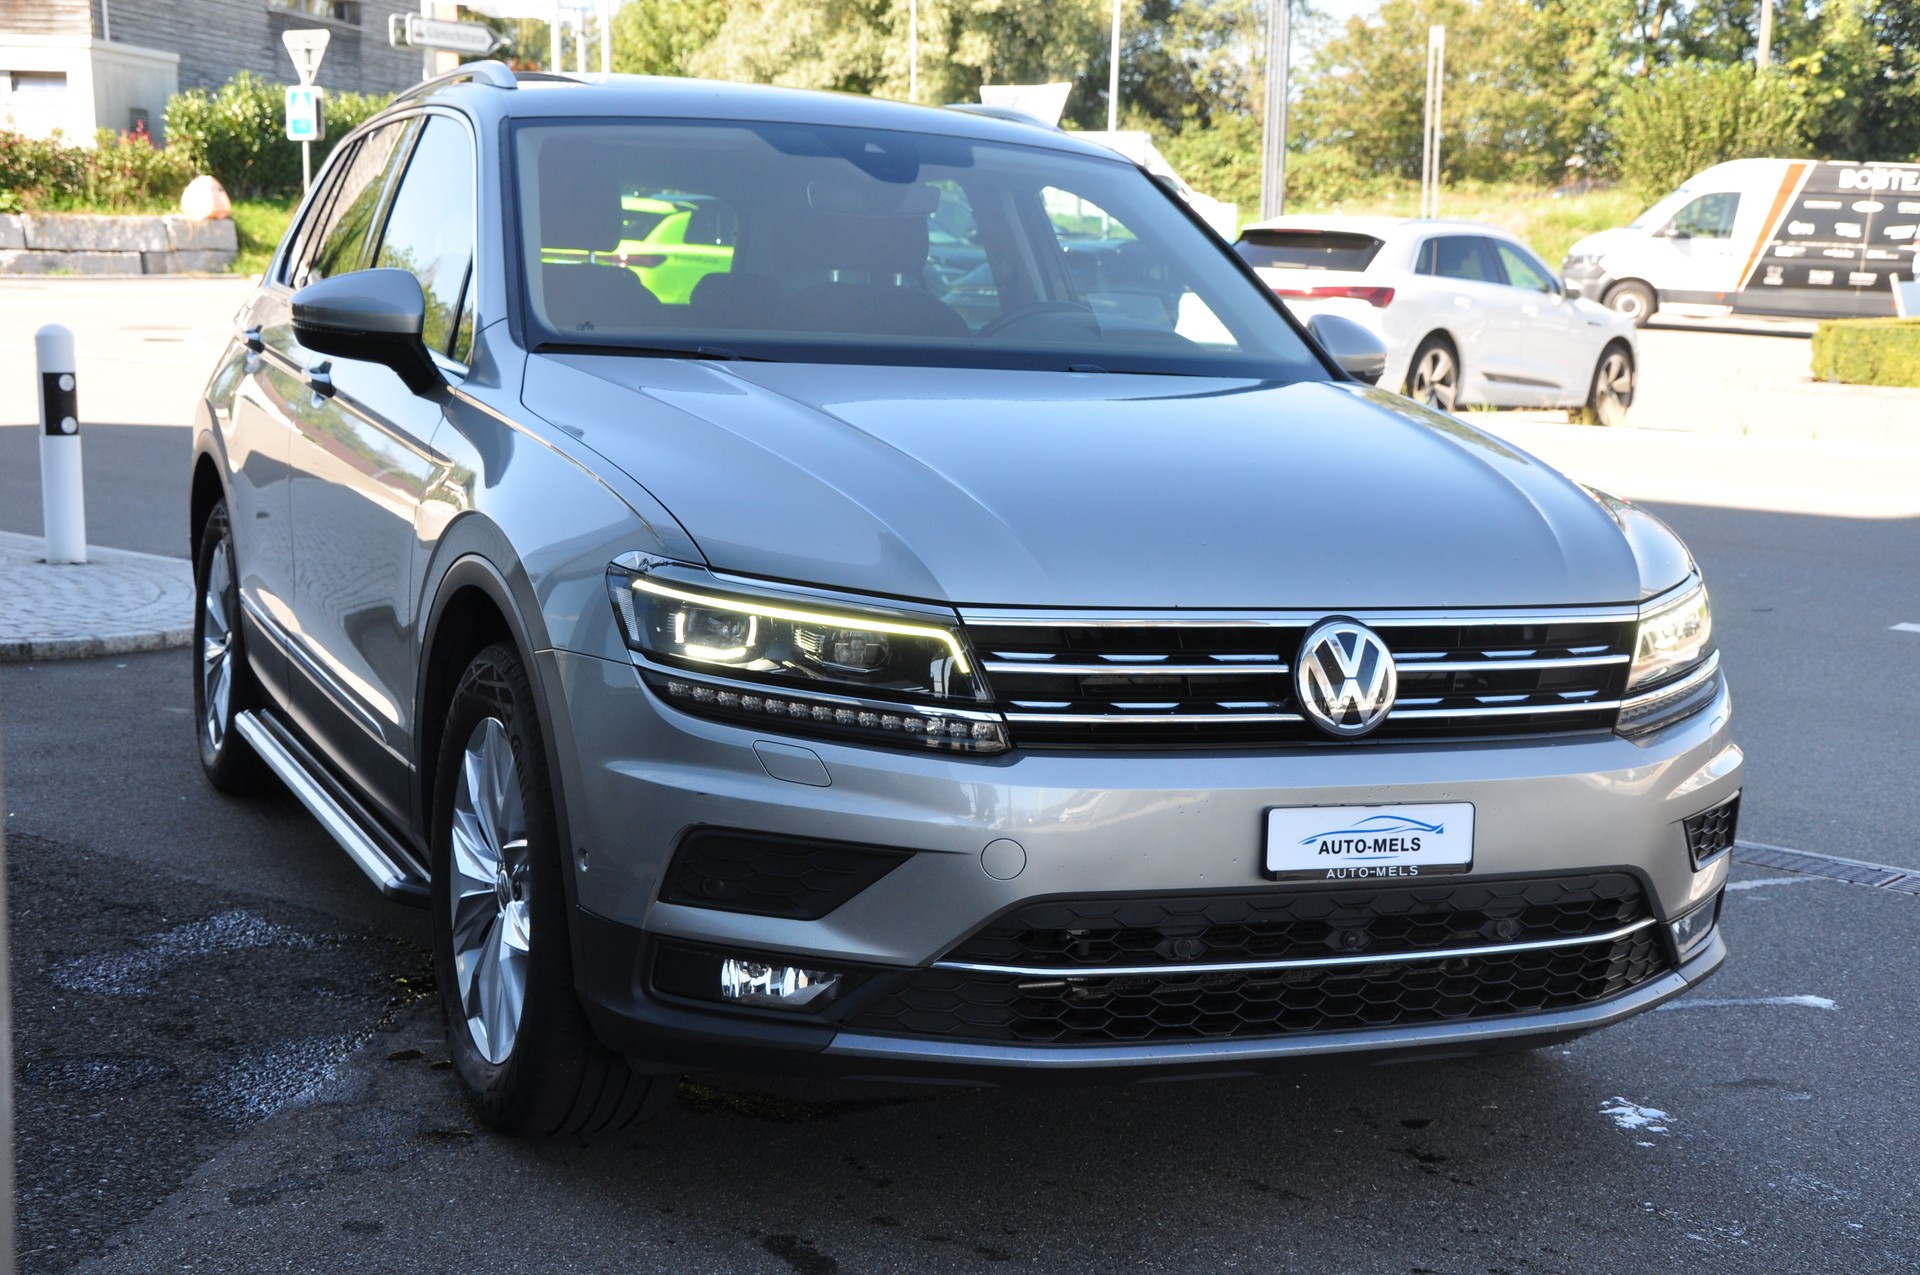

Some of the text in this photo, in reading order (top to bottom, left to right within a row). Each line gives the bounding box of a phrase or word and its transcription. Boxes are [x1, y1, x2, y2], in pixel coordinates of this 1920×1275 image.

[1838, 168, 1920, 192] BOBTE
[1301, 623, 1396, 735] VW
[1318, 837, 1421, 855] AUTO-MELS
[1326, 865, 1419, 879] AUTO-MELS
